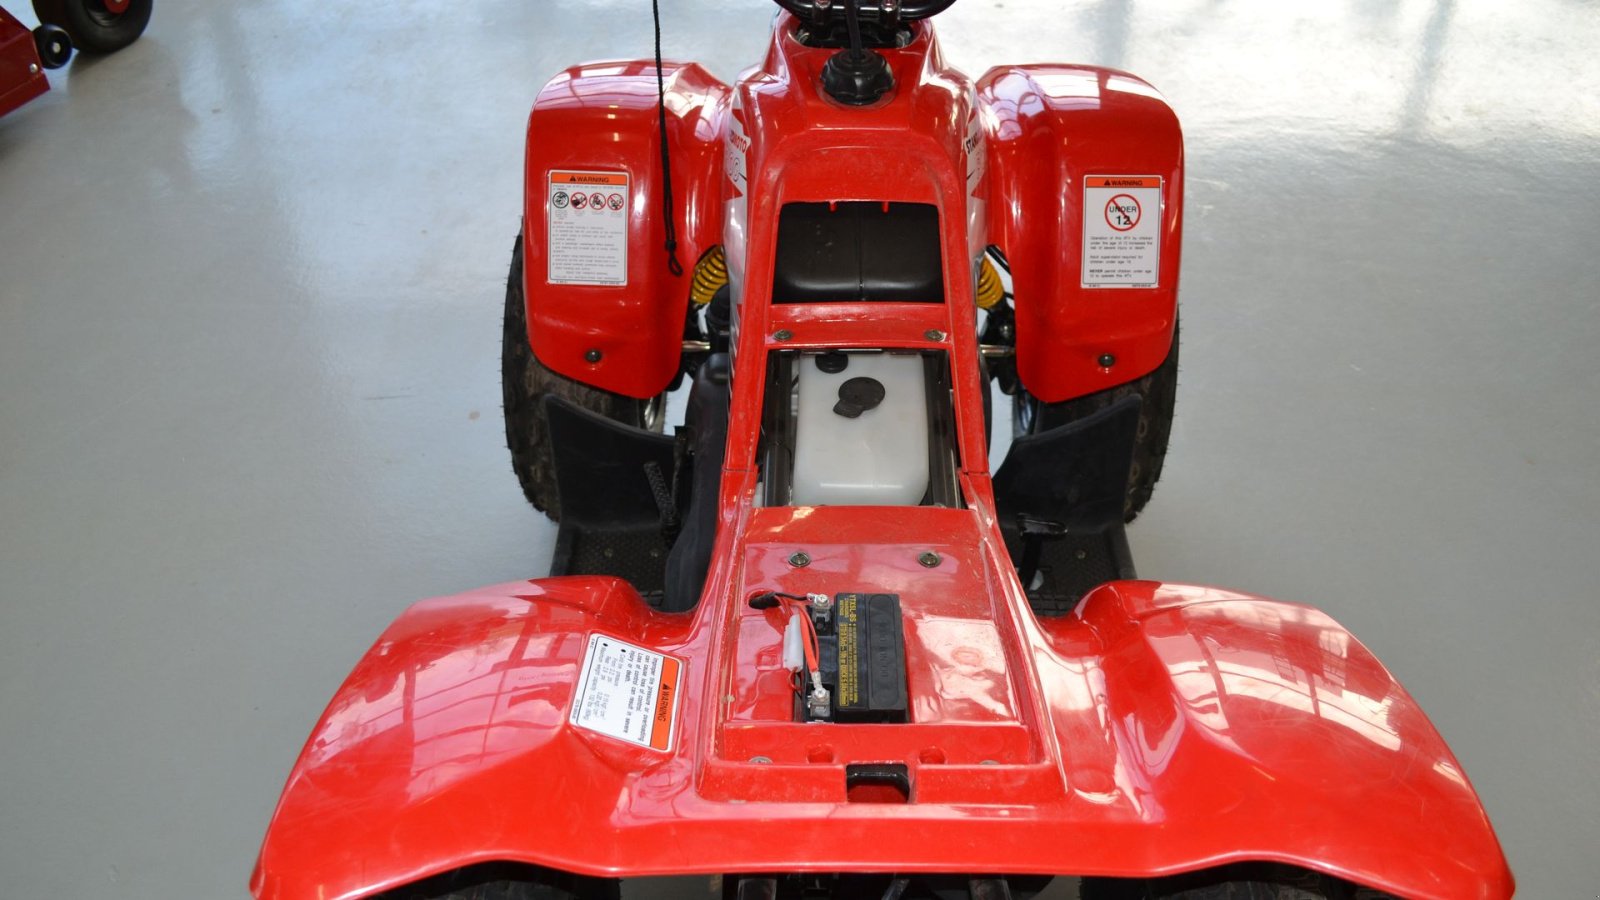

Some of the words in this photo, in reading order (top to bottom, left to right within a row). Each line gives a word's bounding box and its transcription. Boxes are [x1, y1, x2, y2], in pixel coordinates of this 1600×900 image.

[1116, 216, 1130, 225] 12
[645, 686, 653, 705] pressure
[658, 690, 670, 722] WARNING
[638, 714, 648, 741] overloading
